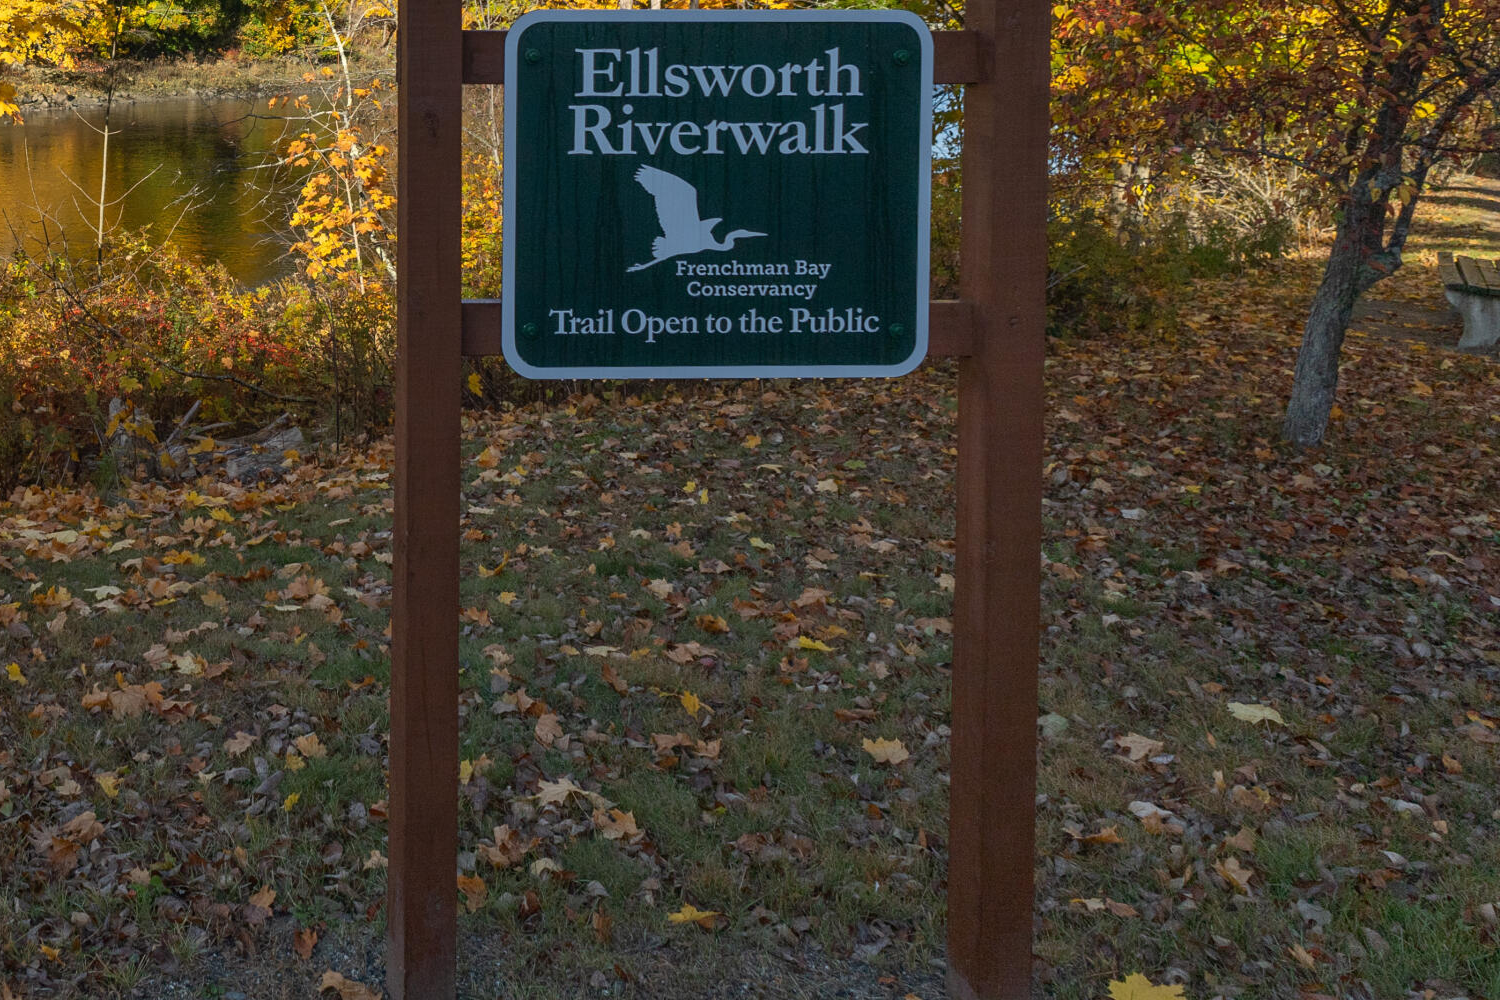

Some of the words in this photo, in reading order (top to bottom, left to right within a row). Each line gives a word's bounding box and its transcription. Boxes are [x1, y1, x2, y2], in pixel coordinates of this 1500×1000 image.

[575, 47, 863, 97] Ellsworth
[567, 103, 869, 155] Riverwalk
[676, 260, 789, 276] Frenchman
[795, 260, 831, 279] Bay
[687, 281, 817, 299] Conservancy
[549, 309, 615, 334] Trail
[621, 309, 699, 343] Open
[705, 314, 732, 334] to
[739, 308, 783, 334] the
[789, 308, 879, 334] Public
